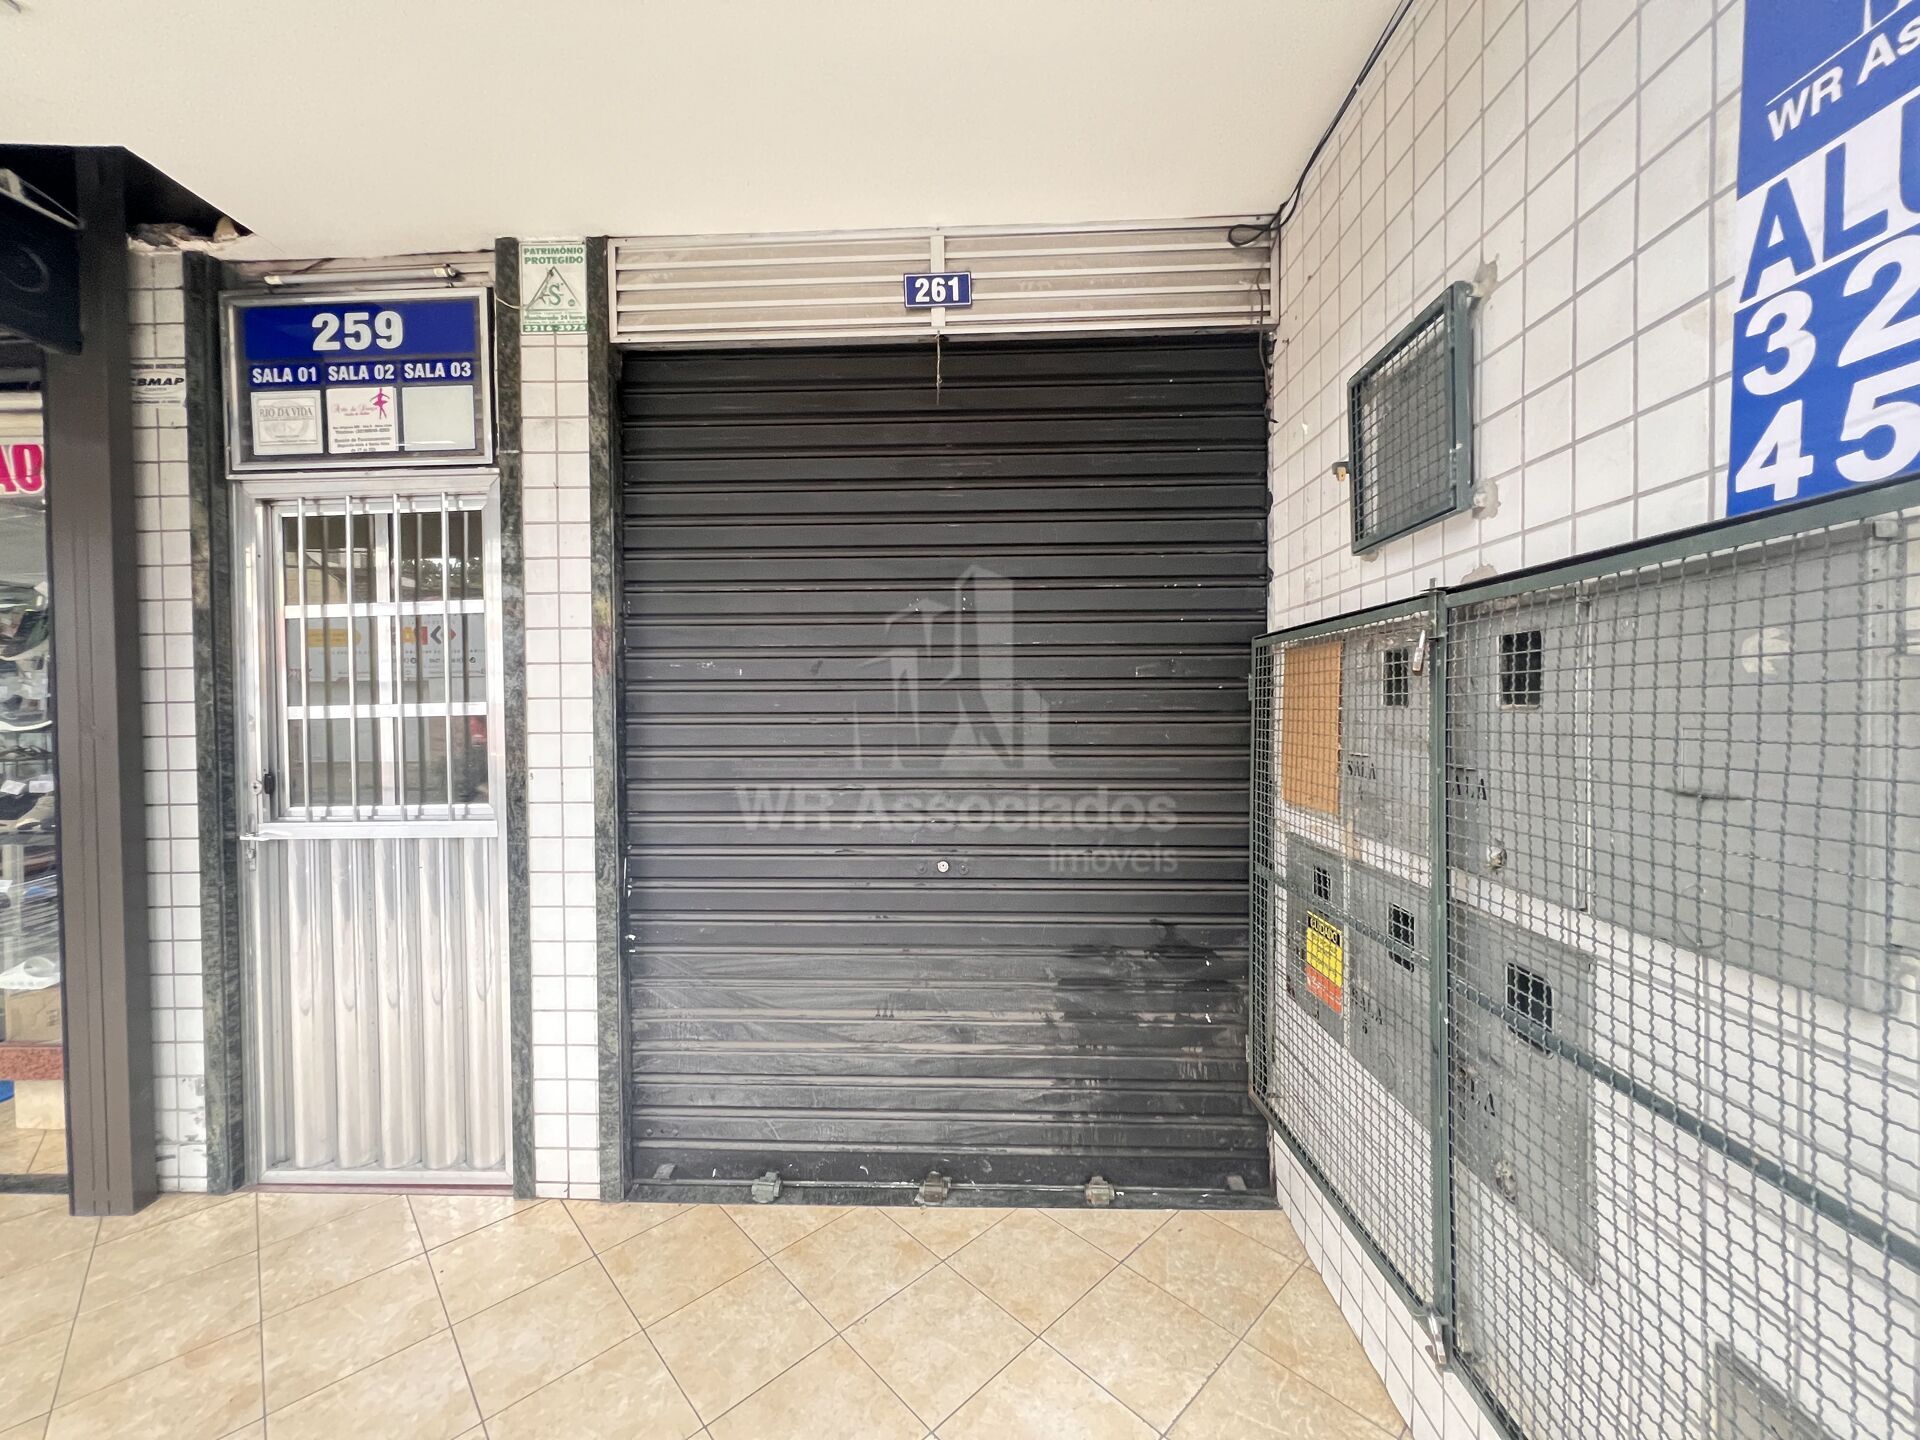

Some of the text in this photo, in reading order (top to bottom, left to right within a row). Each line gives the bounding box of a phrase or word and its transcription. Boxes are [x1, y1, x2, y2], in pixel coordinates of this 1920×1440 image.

[1768, 65, 1844, 142] WR
[523, 256, 584, 265] PROTEGIDO
[914, 276, 960, 303] 261
[311, 310, 404, 351] 259
[252, 366, 318, 384] SALA 01
[328, 363, 395, 381] SALA 02
[404, 361, 472, 379] SALA 03
